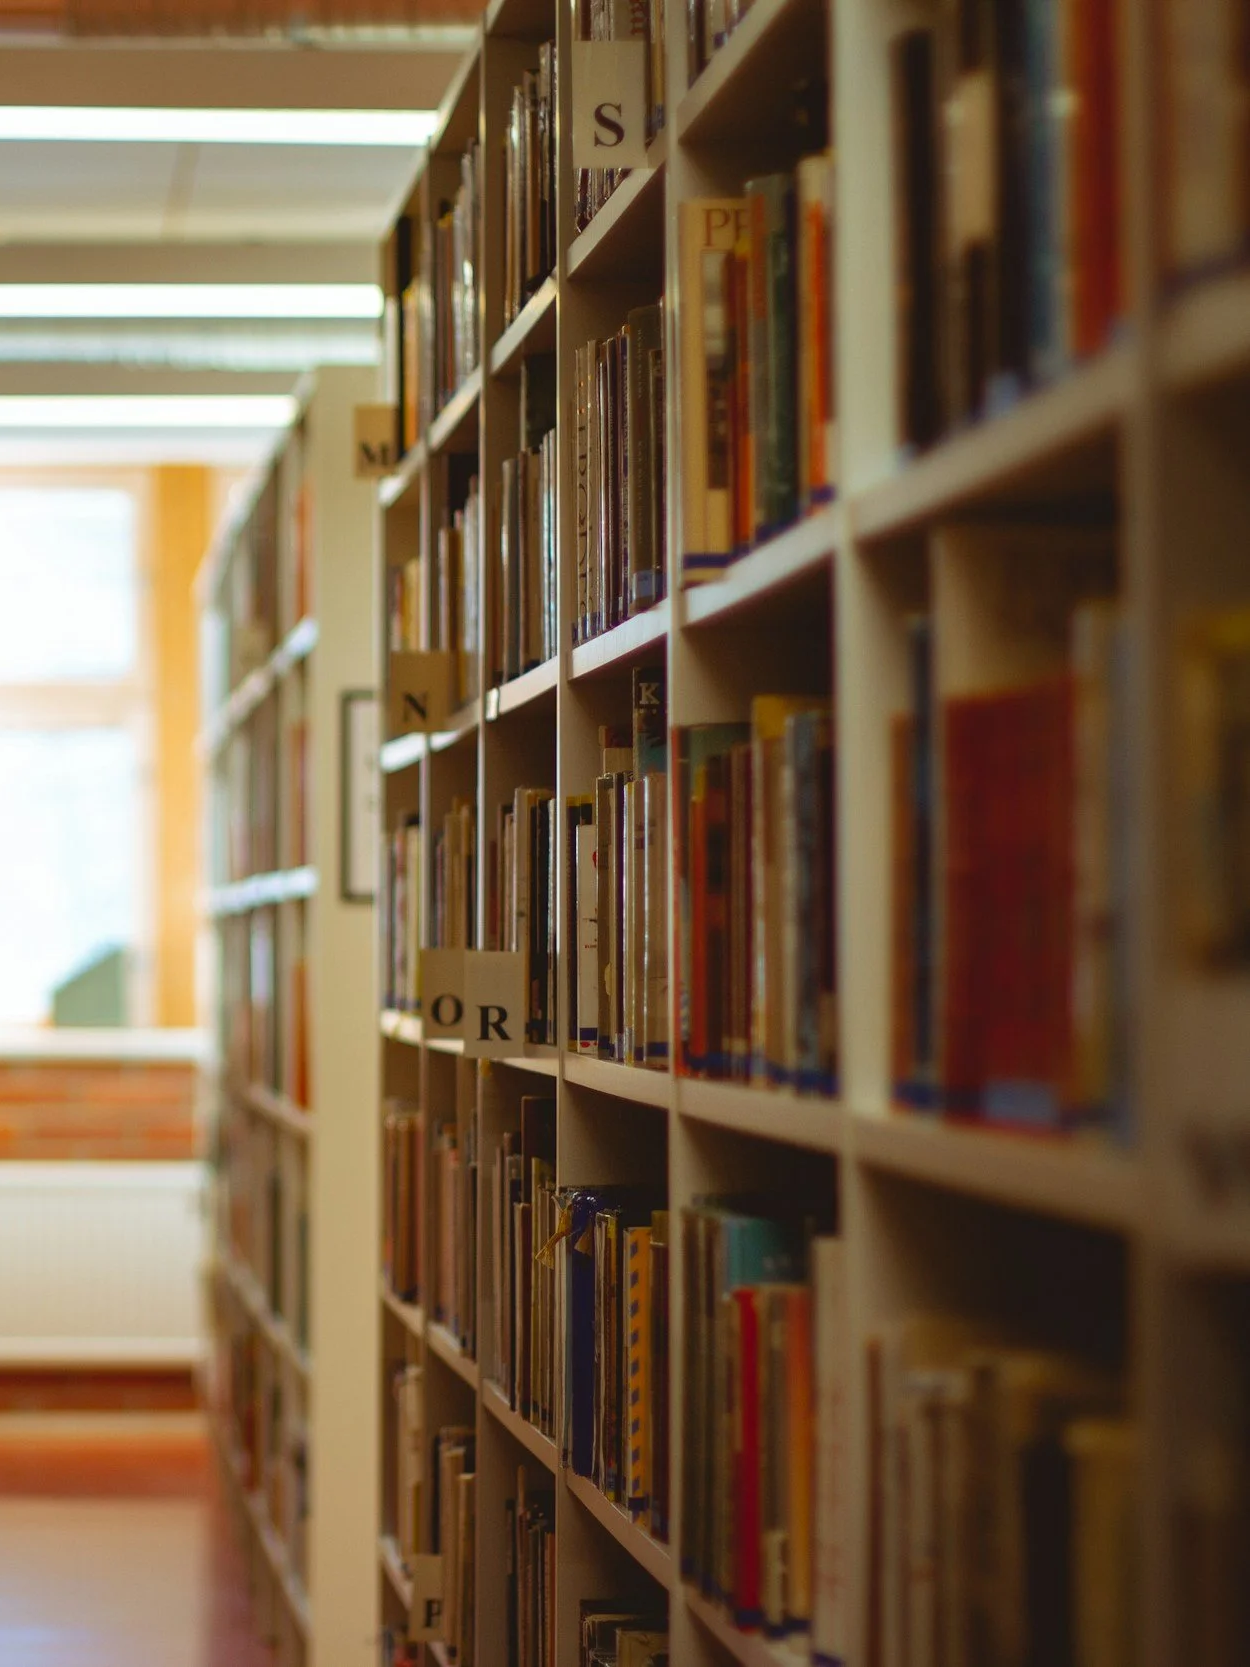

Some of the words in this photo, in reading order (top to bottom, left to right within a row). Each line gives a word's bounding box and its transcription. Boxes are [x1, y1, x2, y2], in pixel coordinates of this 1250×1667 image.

[594, 102, 625, 147] S
[358, 440, 392, 467] M
[401, 690, 429, 723] N
[639, 682, 660, 705] K
[431, 993, 464, 1027] O
[476, 1004, 512, 1041] R
